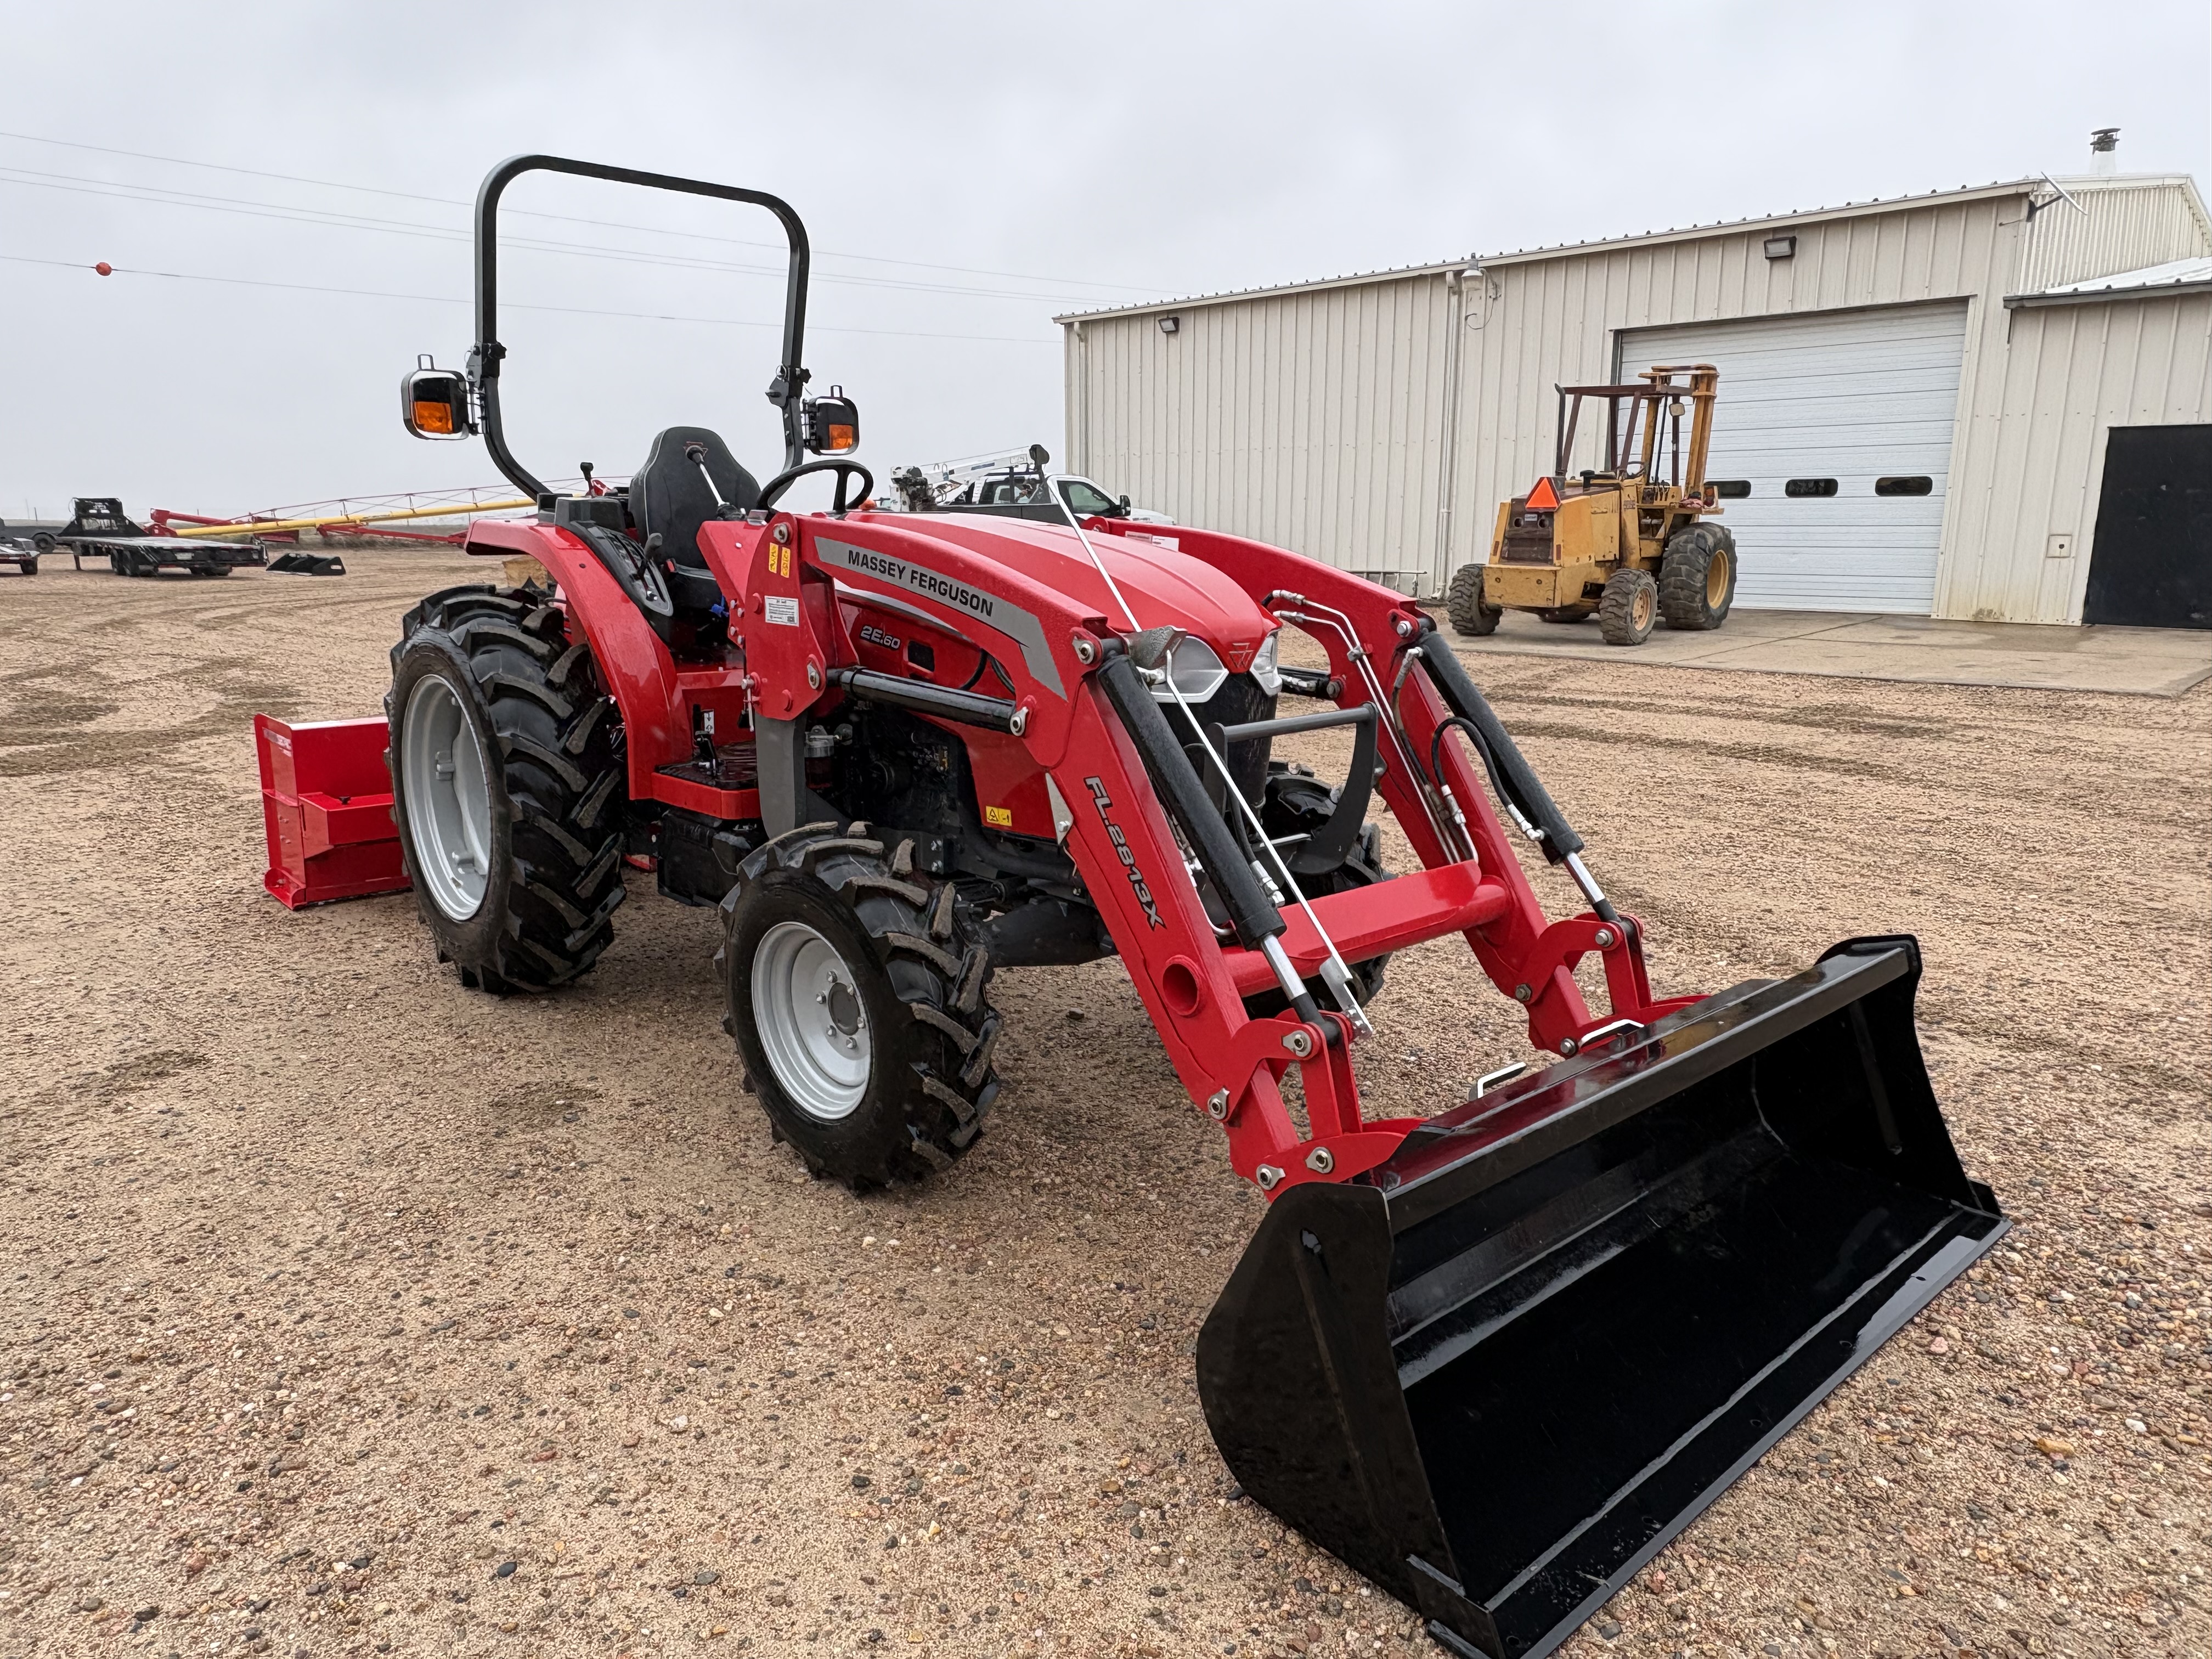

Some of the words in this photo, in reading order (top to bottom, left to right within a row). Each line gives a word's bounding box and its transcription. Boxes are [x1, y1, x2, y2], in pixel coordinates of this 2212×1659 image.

[848, 550, 906, 579] MASSEY
[910, 569, 993, 617] FERGUSON
[860, 625, 900, 649] 2E.60
[1084, 776, 1167, 931] FL.2813X
